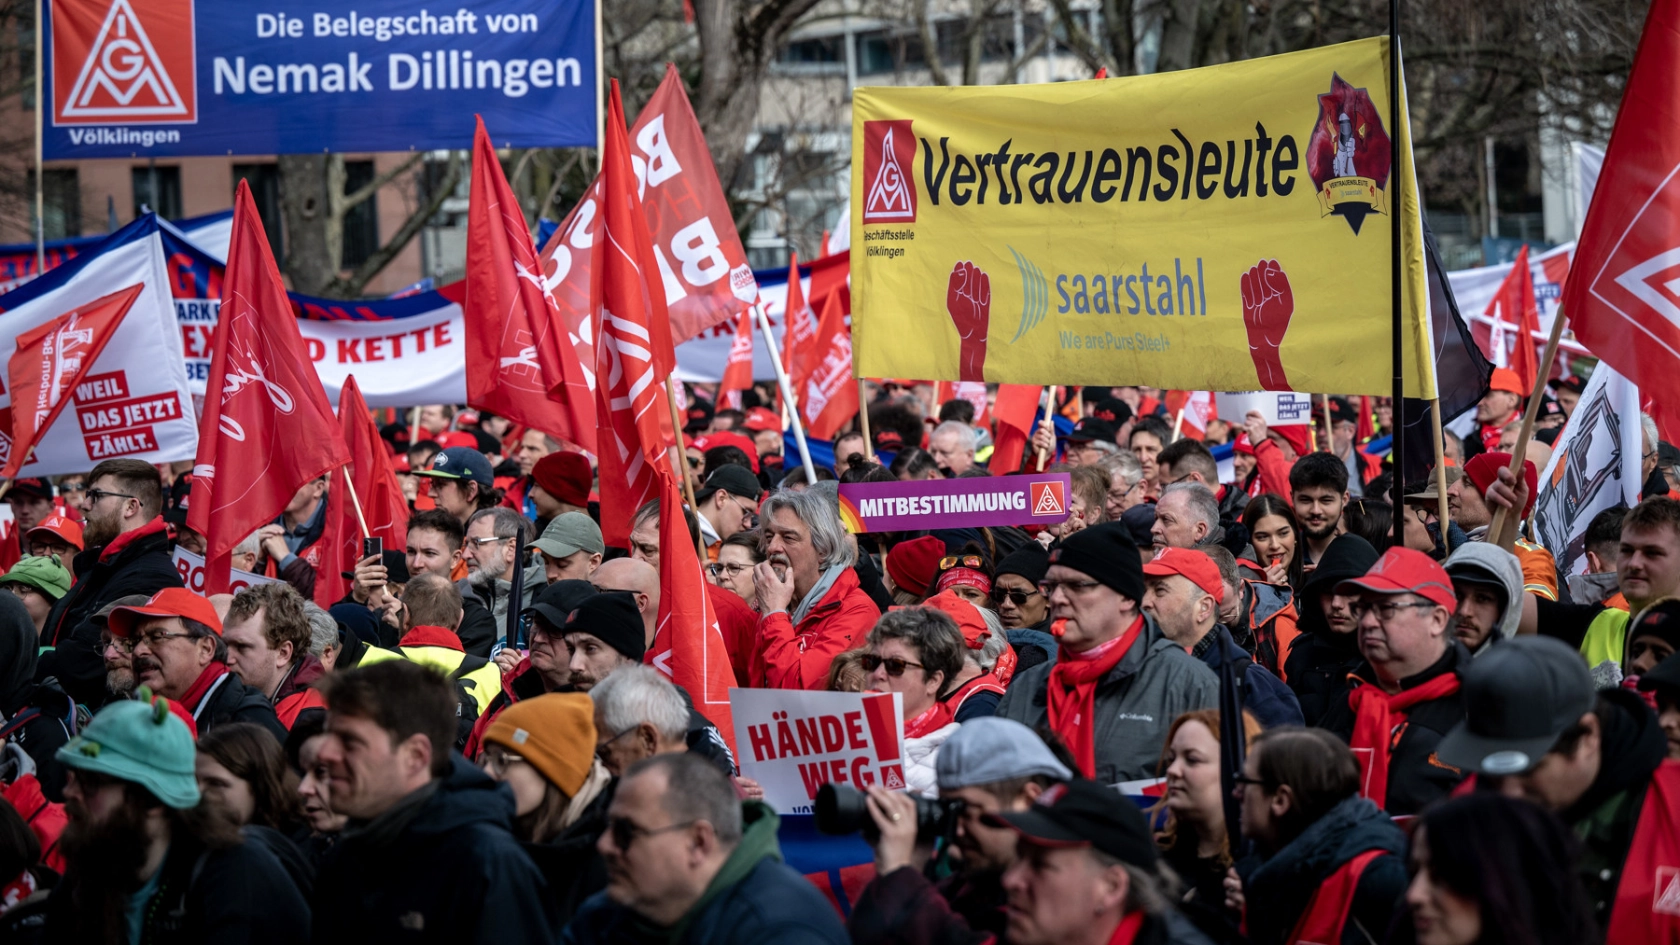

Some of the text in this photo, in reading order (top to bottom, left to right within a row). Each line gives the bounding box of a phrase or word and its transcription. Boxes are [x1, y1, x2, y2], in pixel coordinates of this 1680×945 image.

[256, 9, 538, 41] Die Belegschaft von
[213, 50, 581, 97] Nemak Dillingen
[69, 128, 180, 147] Völklingen
[920, 120, 1299, 206] Vertrauensleute
[1329, 179, 1368, 189] VERTRAUENSLEUTE
[1056, 257, 1206, 316] saarstahl
[337, 320, 452, 364] KETTE
[1059, 331, 1082, 349] We
[1085, 334, 1105, 350] are
[1105, 331, 1135, 350] Pure
[75, 378, 123, 401] WEIL
[82, 398, 175, 430] DAS JETZT
[90, 433, 153, 457] ZÄHLT.
[860, 491, 1026, 518] MITBESTIMMUNG
[747, 710, 868, 762] HÄNDE
